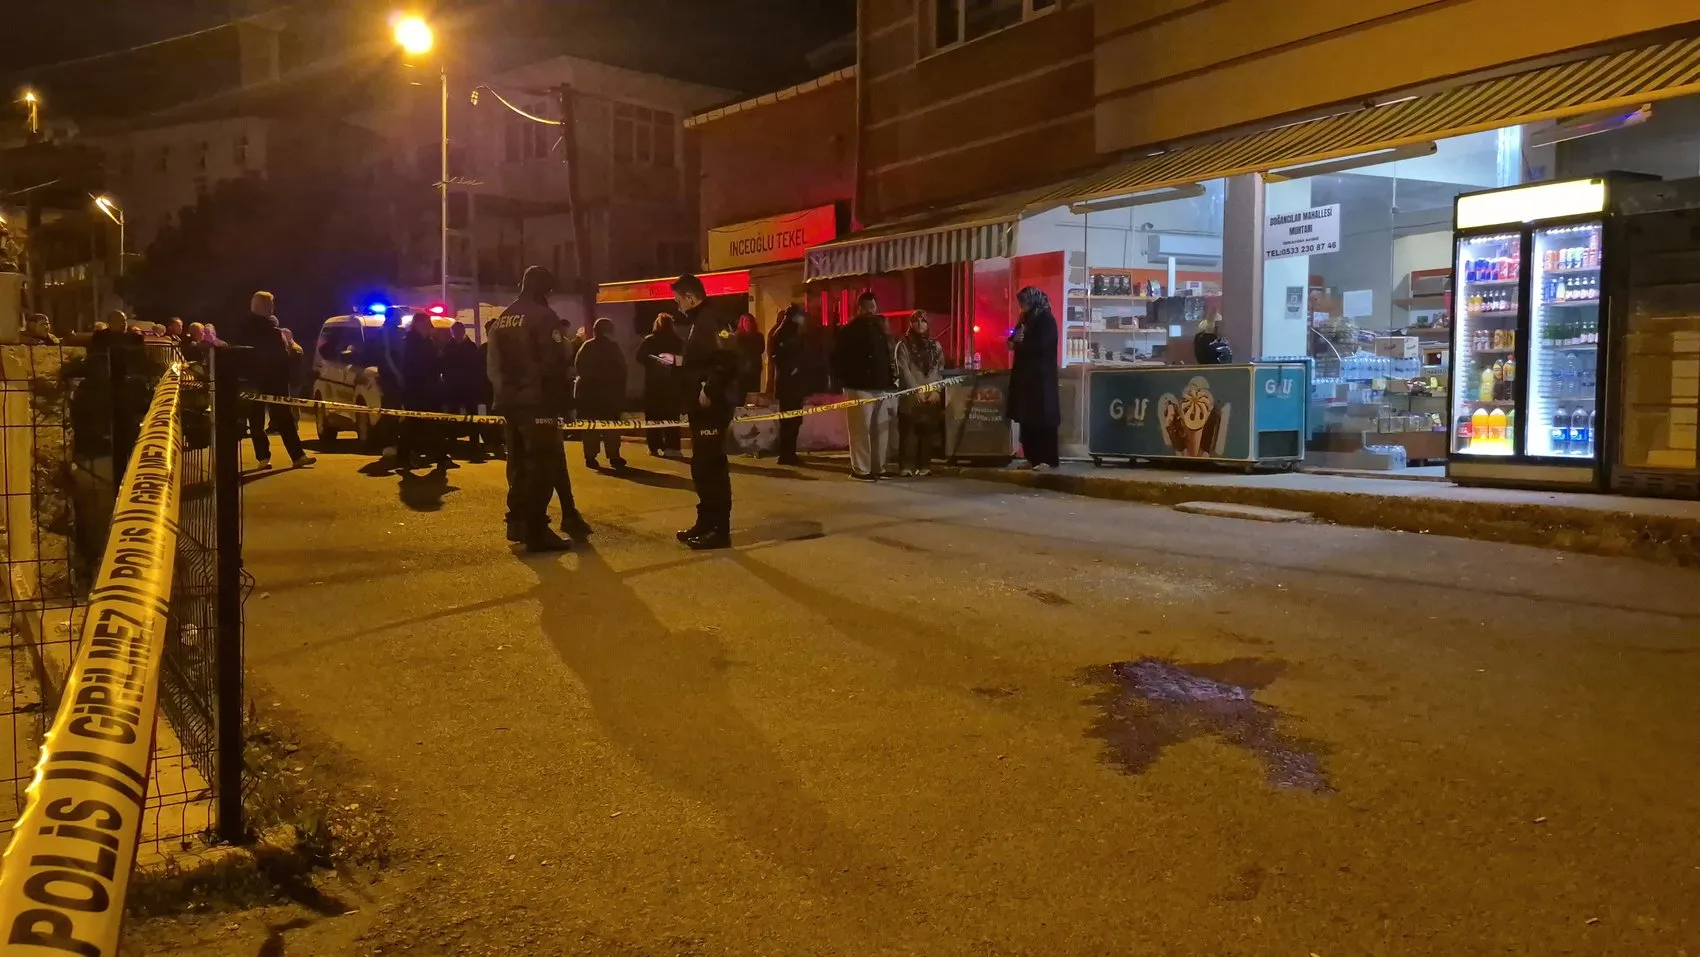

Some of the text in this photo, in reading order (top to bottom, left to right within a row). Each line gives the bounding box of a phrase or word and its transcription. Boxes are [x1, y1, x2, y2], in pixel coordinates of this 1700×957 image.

[1270, 206, 1332, 226] DOĞANCILAR MAHALLESİ
[776, 228, 807, 248] TEKEL
[1289, 224, 1313, 235] MUHTARI
[1266, 246, 1299, 257] TEL:0533
[1301, 244, 1314, 253] 230
[1316, 243, 1325, 251] 87
